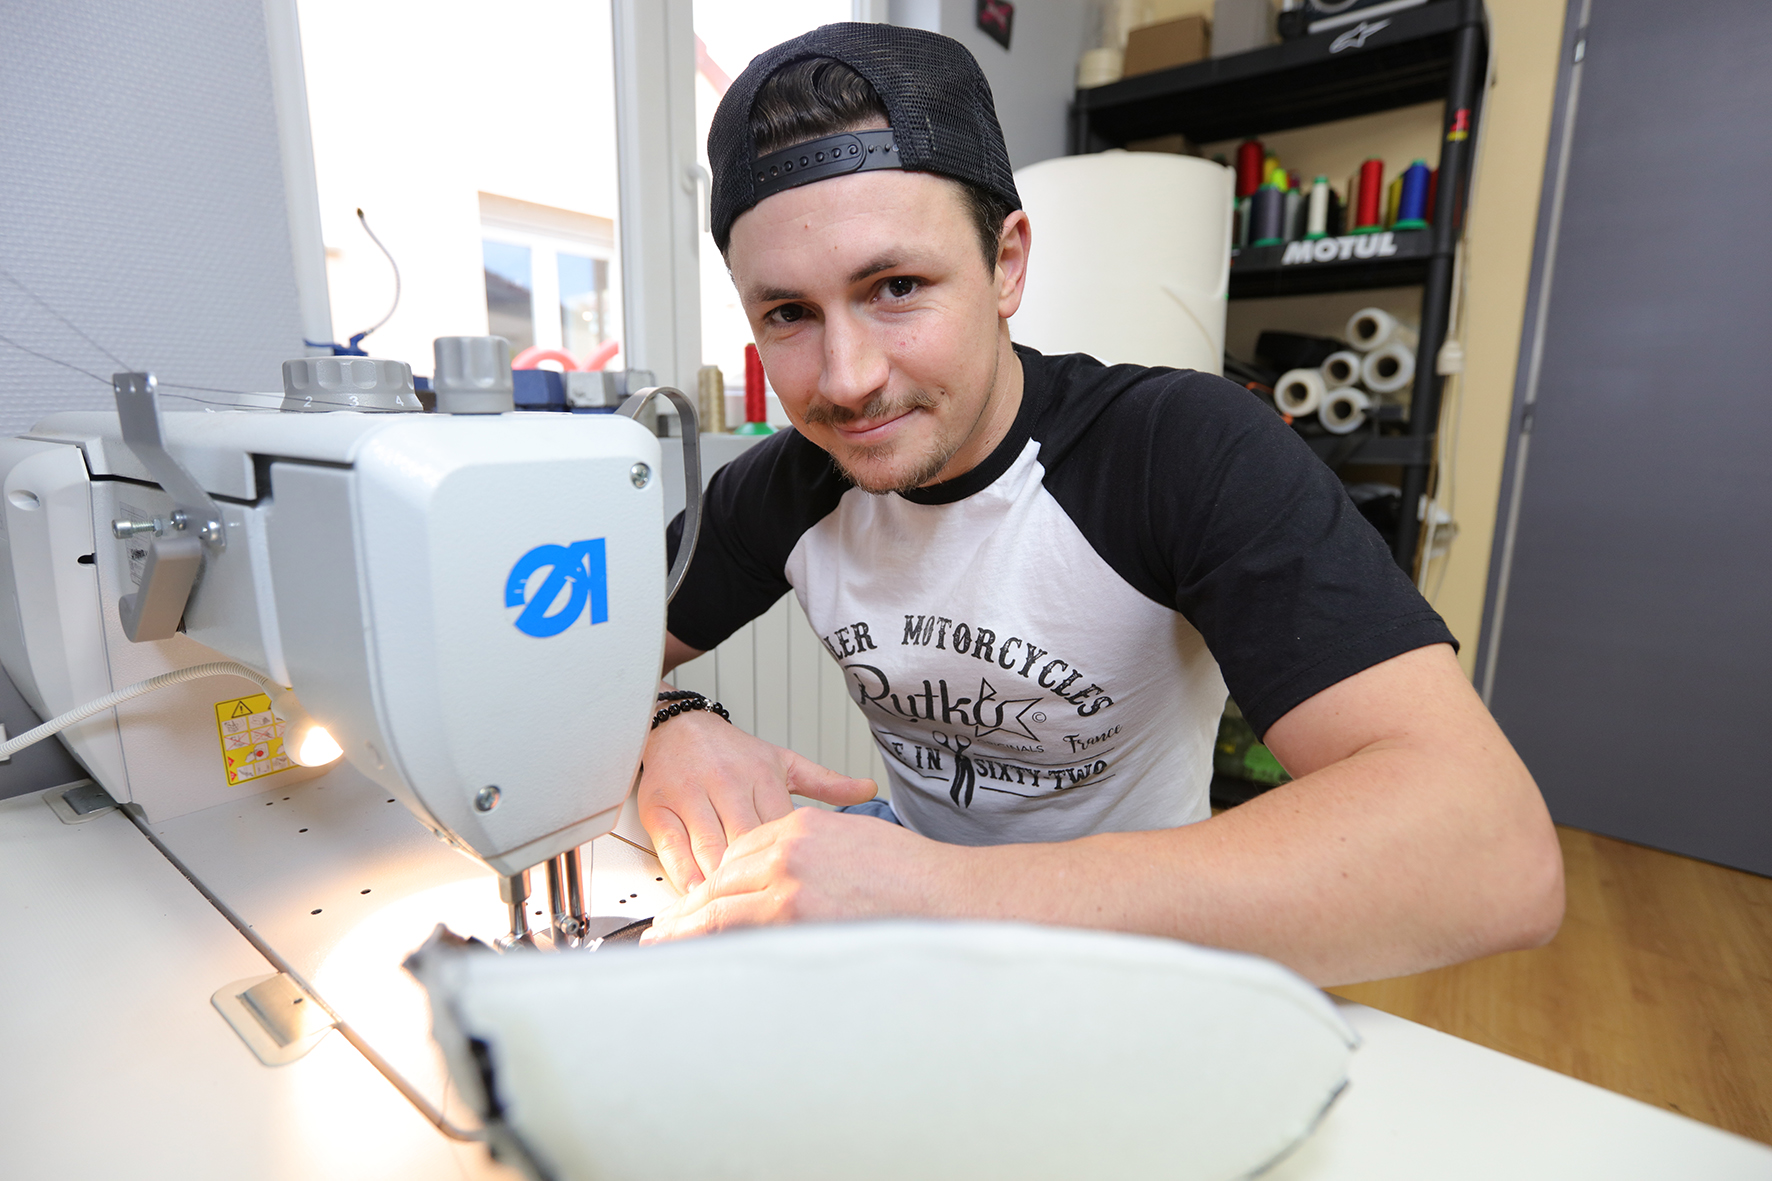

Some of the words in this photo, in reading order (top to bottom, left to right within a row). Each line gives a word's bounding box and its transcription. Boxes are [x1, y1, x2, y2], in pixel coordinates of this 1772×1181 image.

[1281, 231, 1398, 265] MOTUL
[303, 395, 313, 408] 2
[349, 395, 360, 408] 3
[395, 395, 404, 407] 4
[901, 614, 1115, 717] MOTORCYCLES
[1063, 724, 1123, 754] France
[914, 745, 943, 770] IN
[973, 758, 1108, 790] SIXTY-TWO
